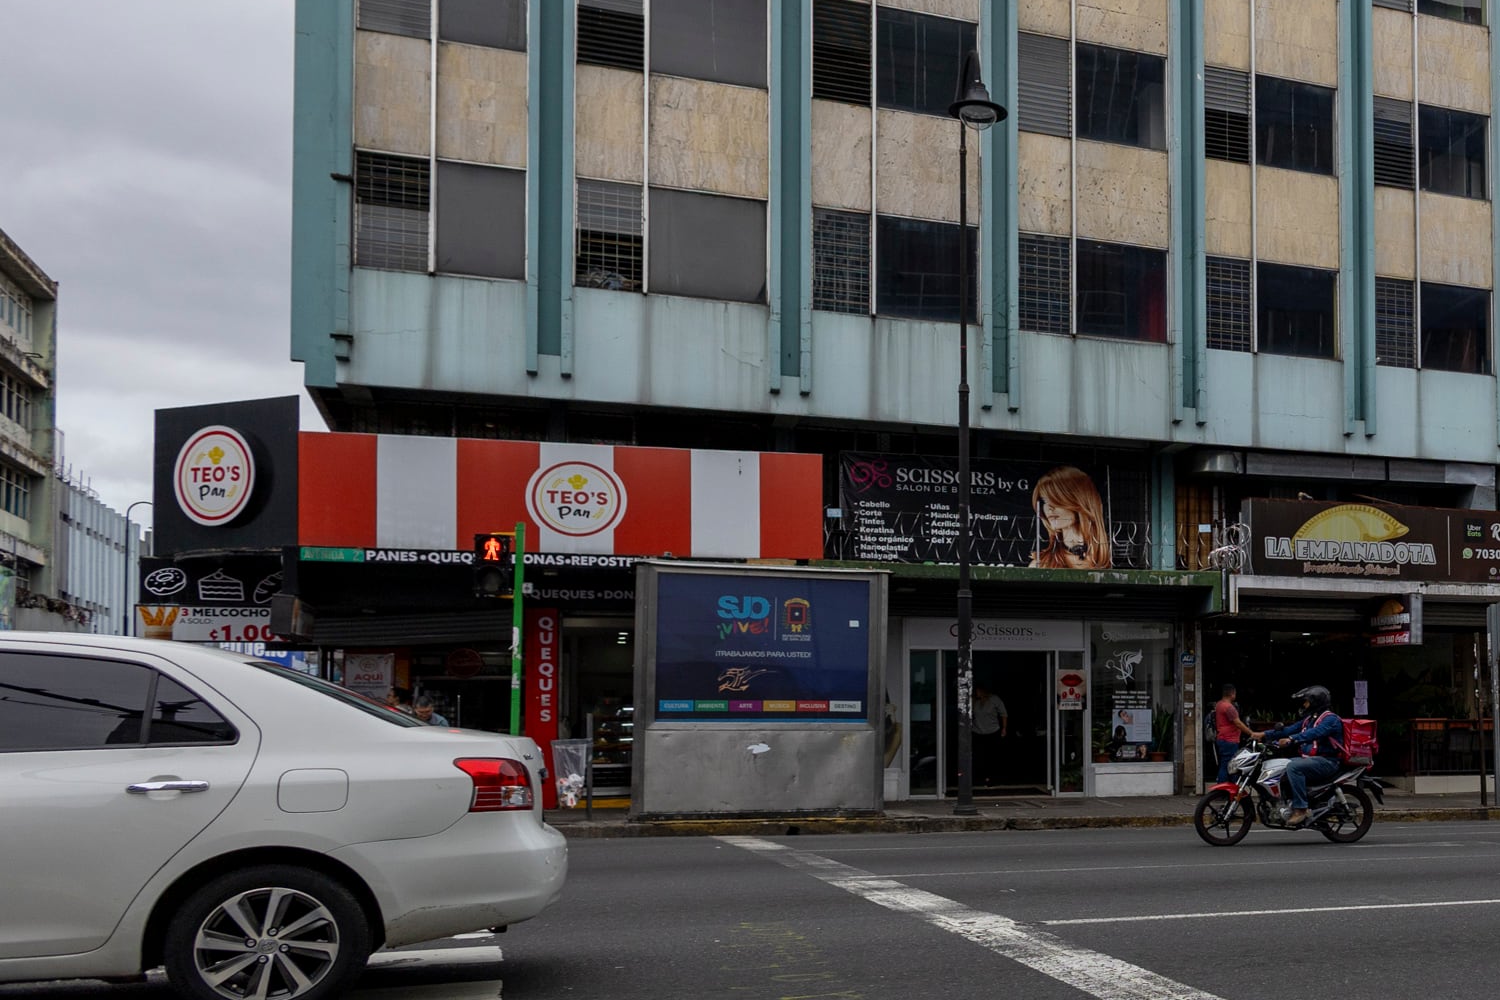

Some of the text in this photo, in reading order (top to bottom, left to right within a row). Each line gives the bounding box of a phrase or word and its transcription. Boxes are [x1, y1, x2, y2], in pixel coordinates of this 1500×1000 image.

[191, 466, 240, 483] TEO'S
[896, 484, 996, 495] SALON DE BLEZA
[998, 477, 1014, 492] by
[1017, 479, 1029, 491] G
[198, 484, 226, 501] Pan
[546, 490, 609, 505] TEO'S
[558, 506, 591, 519] Pan
[859, 509, 882, 517] Corte
[859, 526, 895, 534] Keratina
[365, 549, 417, 562] PANES
[1264, 536, 1437, 565] LA EMPANADOTA
[531, 589, 596, 601] QUEQUES
[181, 608, 189, 616] 3
[977, 623, 1033, 636] Scissors
[538, 617, 555, 722] QUEQUES
